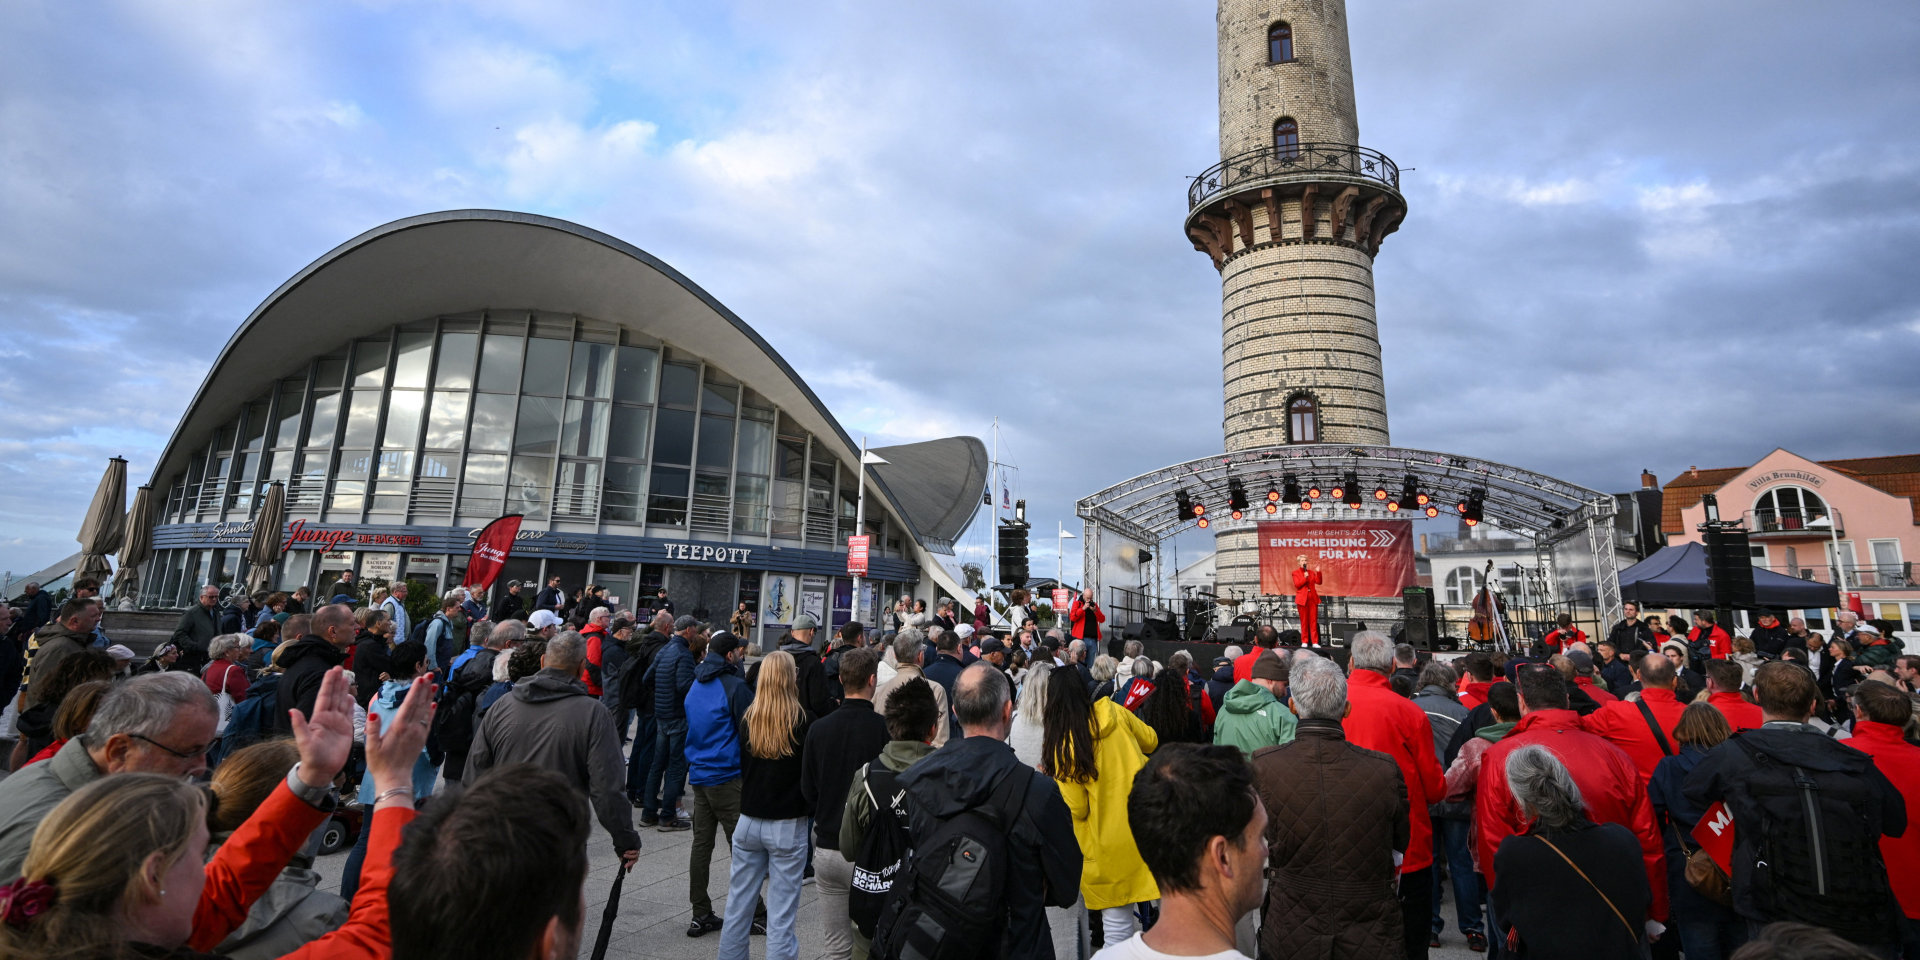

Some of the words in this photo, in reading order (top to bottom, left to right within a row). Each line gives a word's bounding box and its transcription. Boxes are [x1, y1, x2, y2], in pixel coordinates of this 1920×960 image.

[1750, 476, 1771, 488] Villa
[1772, 472, 1820, 485] Brunhilde
[282, 518, 354, 554] Junge
[357, 534, 373, 544] DIE
[1270, 538, 1367, 547] ENTSCHEIDUNG
[474, 542, 505, 559] Junge
[664, 543, 751, 563] TEEPOTT
[1319, 548, 1344, 559] FÜR
[1348, 550, 1371, 559] MV.
